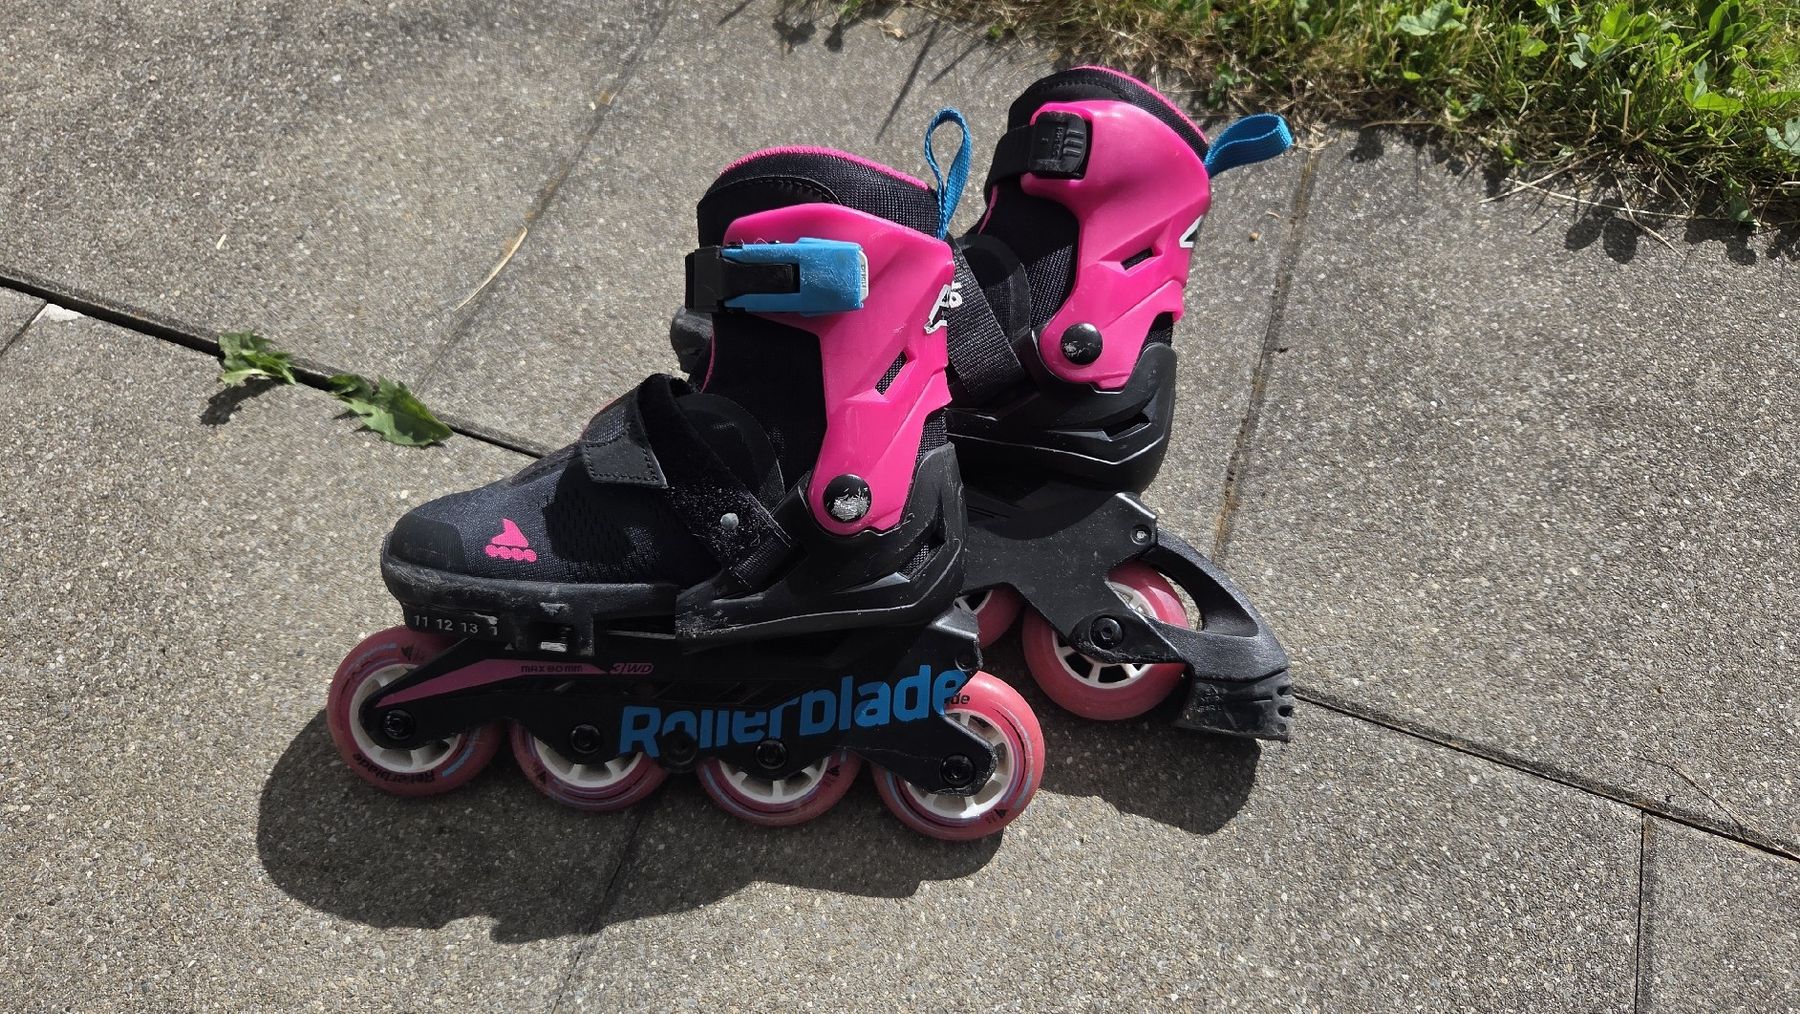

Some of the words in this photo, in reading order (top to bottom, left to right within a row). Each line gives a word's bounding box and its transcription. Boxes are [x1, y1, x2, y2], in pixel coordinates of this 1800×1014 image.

[414, 615, 428, 628] 11
[436, 618, 454, 631] 12
[460, 622, 479, 634] 13
[618, 664, 968, 758] Rollerblade
